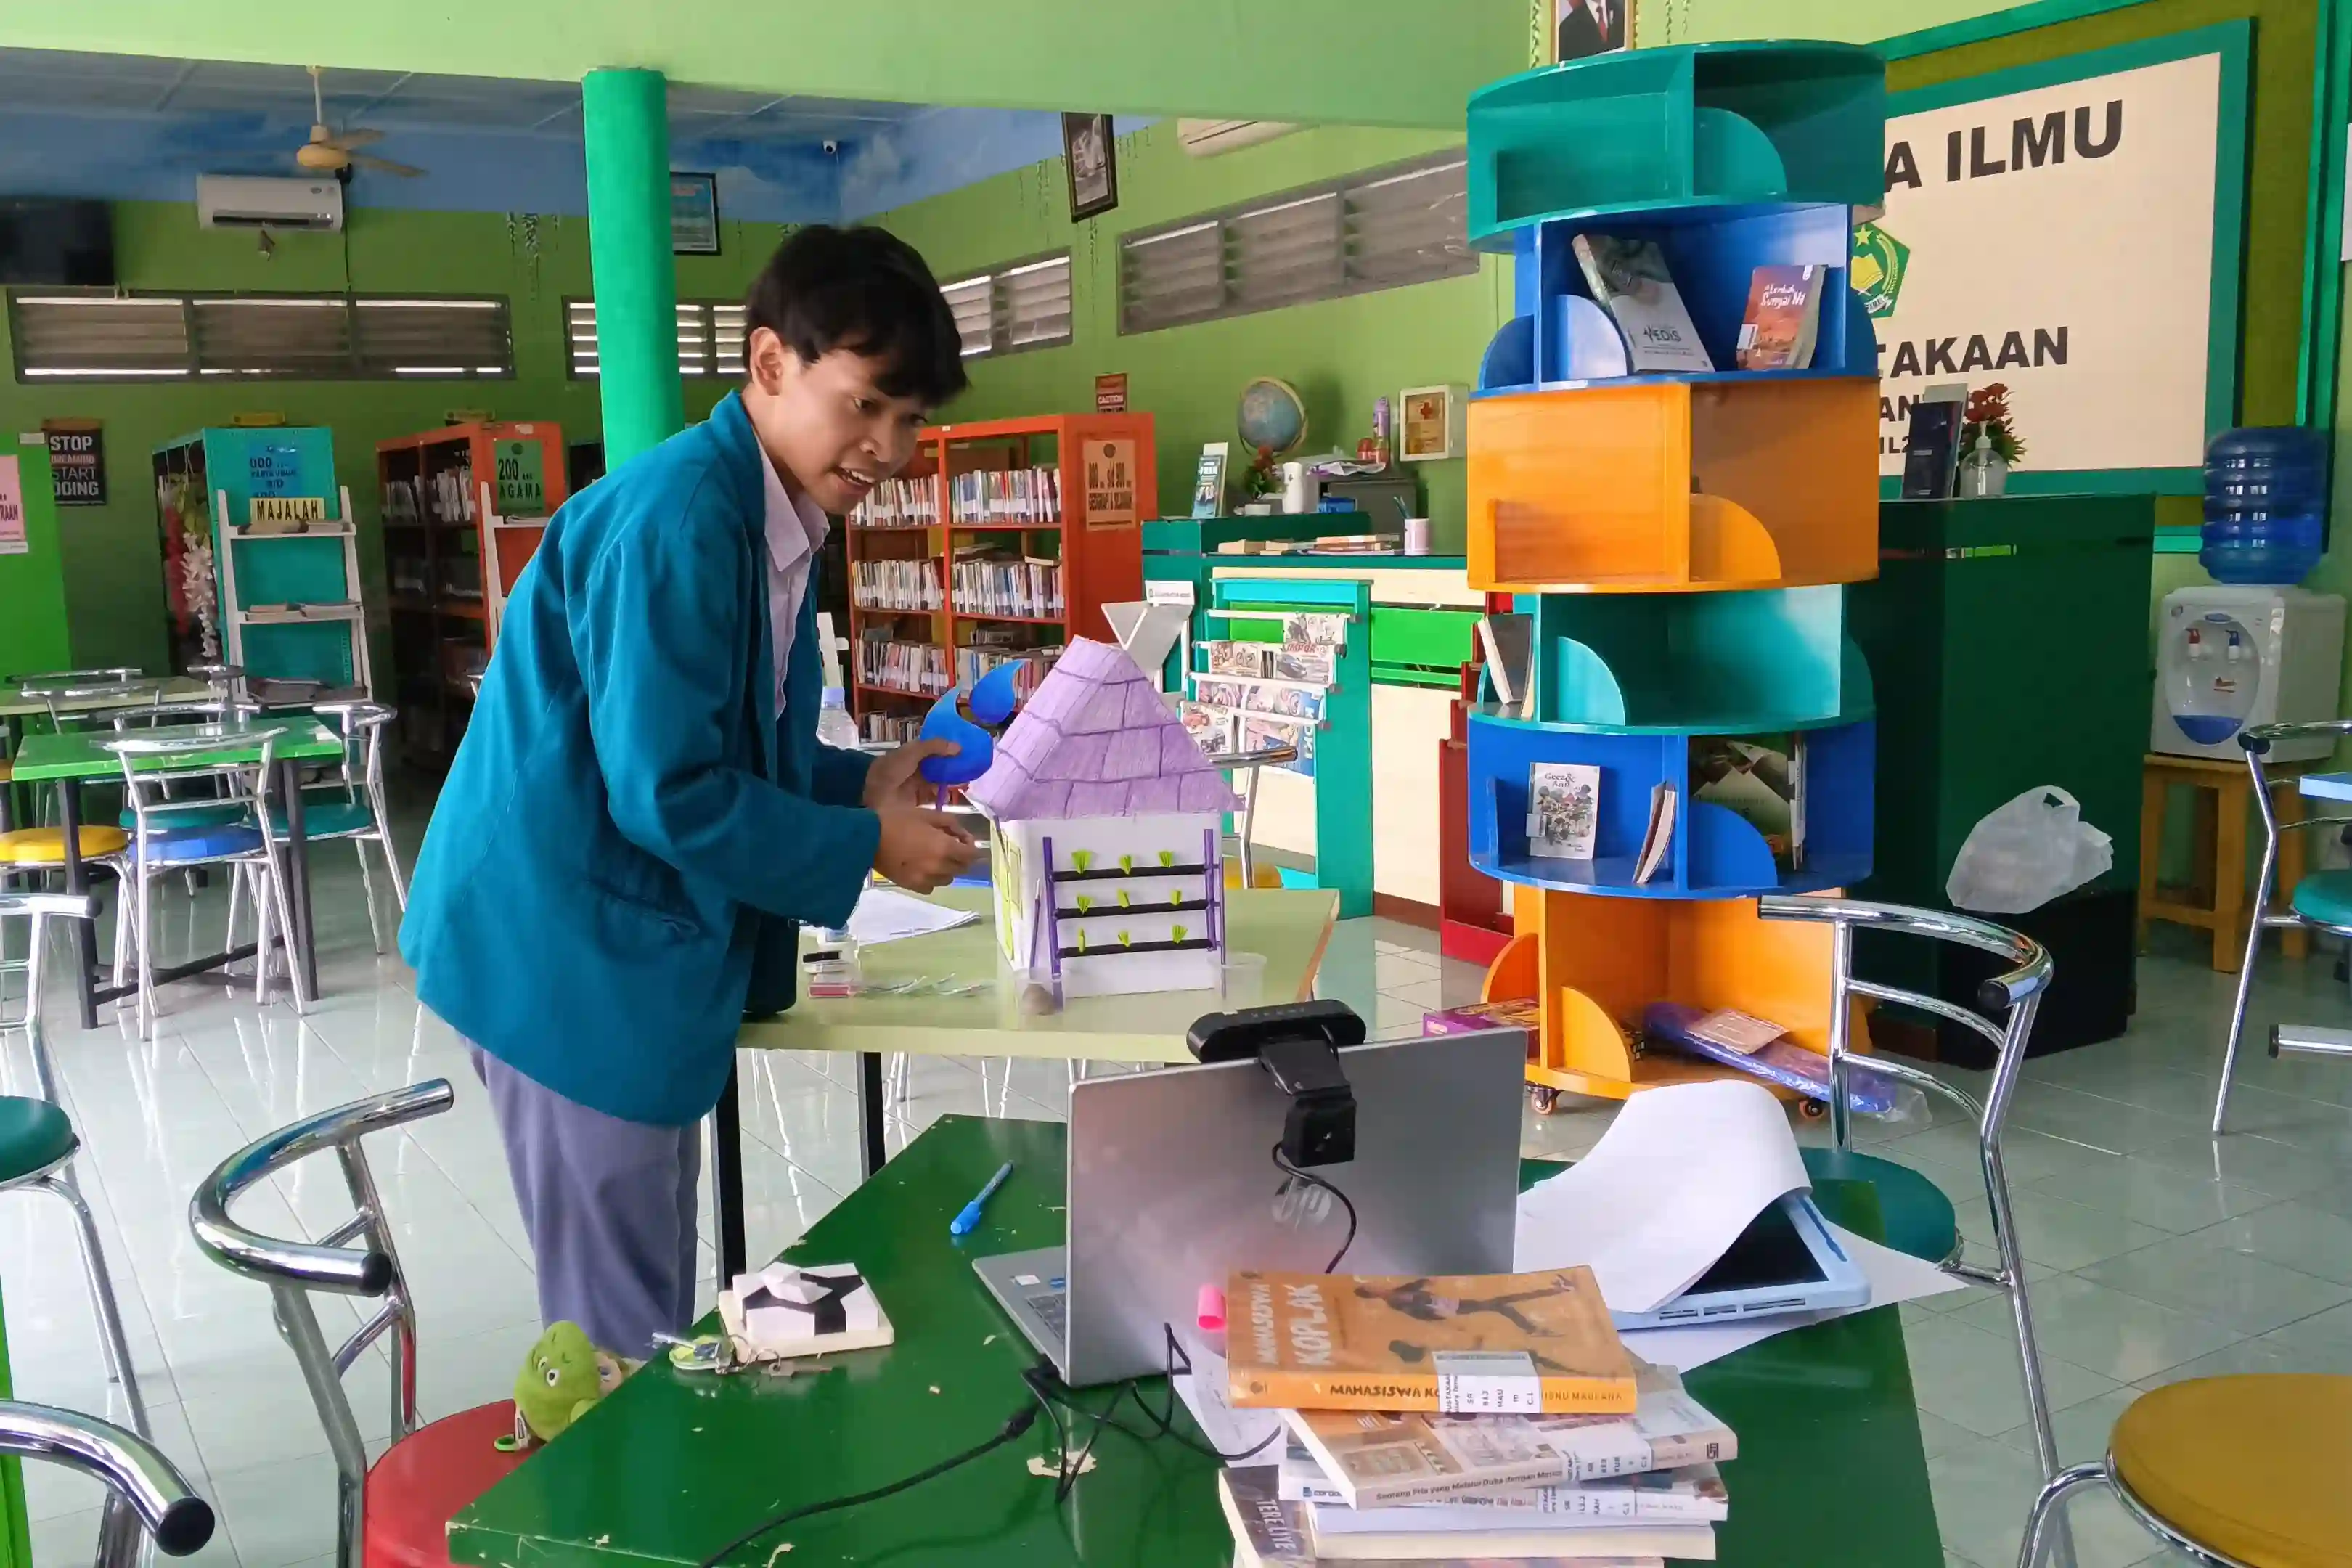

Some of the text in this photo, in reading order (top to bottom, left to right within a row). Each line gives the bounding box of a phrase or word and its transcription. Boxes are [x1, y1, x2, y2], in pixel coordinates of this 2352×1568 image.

[1947, 99, 2123, 182] ILMU
[50, 436, 93, 451] STOP
[52, 467, 96, 480] START
[498, 458, 518, 481] 200
[54, 481, 99, 496] DOING
[499, 483, 541, 501] AGAMA
[256, 499, 319, 520] MAJALAH
[1282, 1283, 1336, 1365] KOPLAK
[1331, 1385, 1421, 1397] MAHASISWA
[1541, 1392, 1569, 1400] ISNU
[1572, 1392, 1622, 1401] MAULANA
[1376, 1491, 1411, 1500] Seorang
[1430, 1485, 1450, 1496] yang
[1505, 1474, 1536, 1484] dengan
[1257, 1499, 1297, 1551] TERE LIYE
